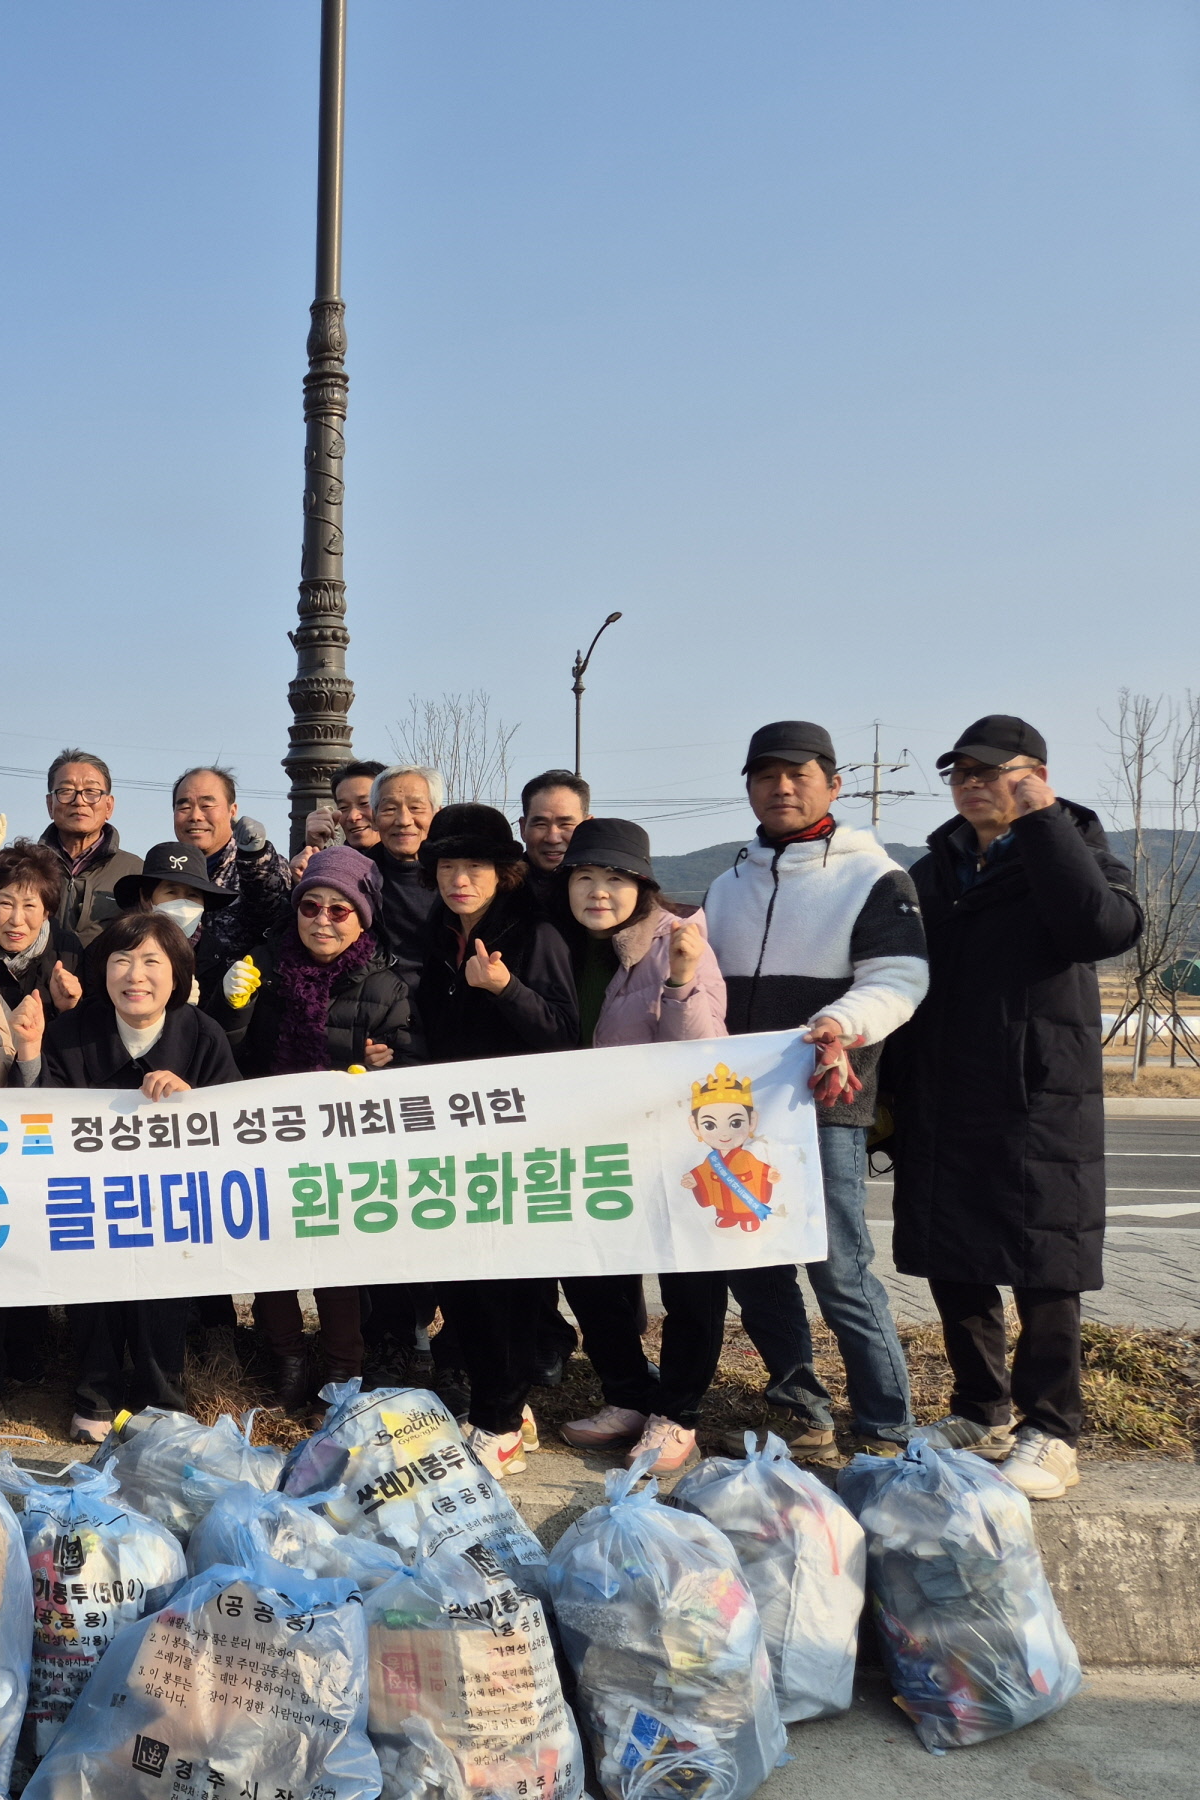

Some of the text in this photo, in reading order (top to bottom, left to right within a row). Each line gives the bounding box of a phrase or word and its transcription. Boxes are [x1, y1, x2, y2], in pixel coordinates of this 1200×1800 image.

[70, 1112, 220, 1153] 정상회의
[232, 1105, 307, 1145] 성공
[318, 1095, 436, 1140] 개최를
[448, 1087, 528, 1128] 위한
[45, 1167, 270, 1252] 클린데이
[287, 1142, 636, 1239] 환경정화활동
[373, 1407, 451, 1447] Beautiful
[154, 1648, 193, 1671] 쓰레기를
[241, 1676, 296, 1702] 사용하여야
[162, 1670, 193, 1692] 봉투는
[232, 1695, 265, 1714] 지정한
[268, 1704, 316, 1728] 사람만이
